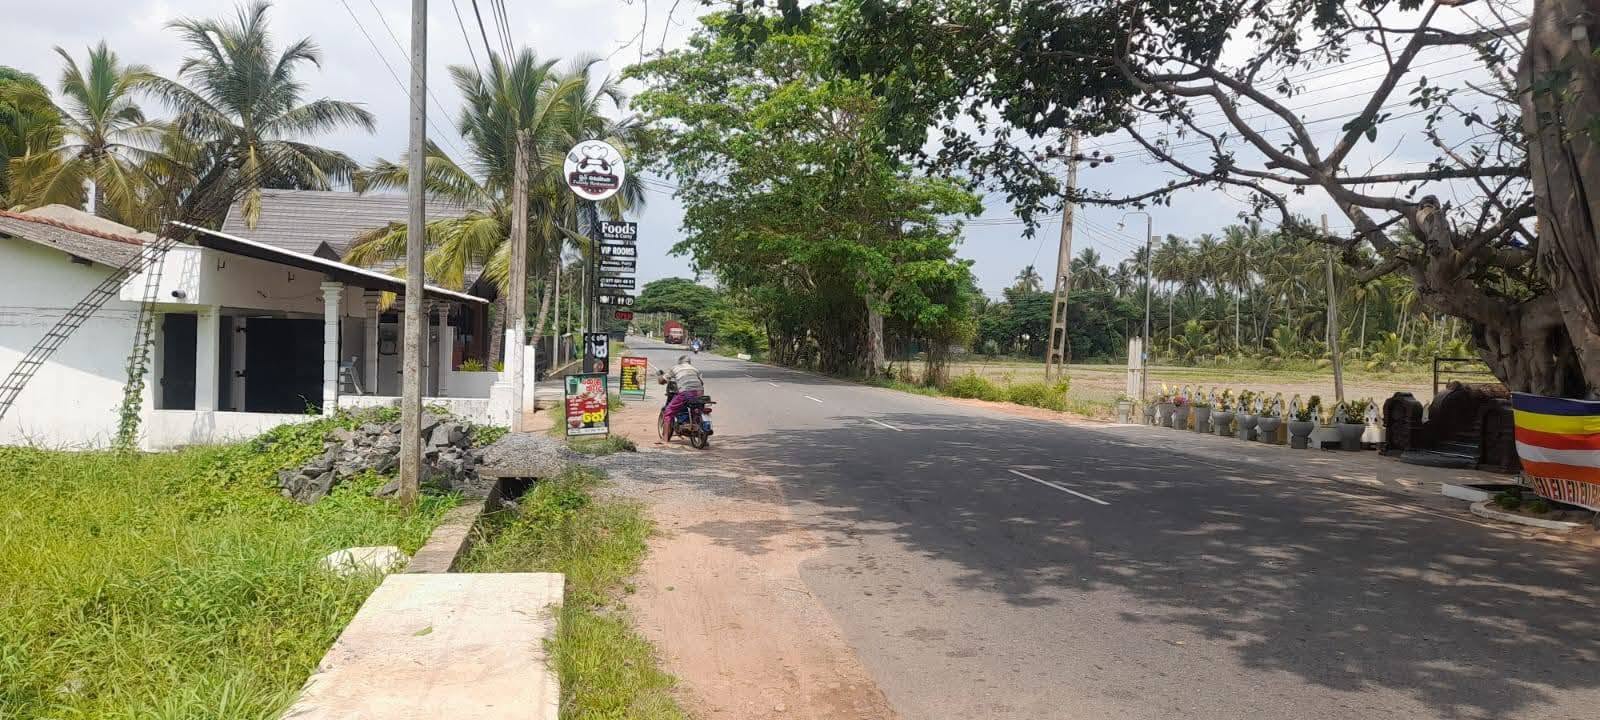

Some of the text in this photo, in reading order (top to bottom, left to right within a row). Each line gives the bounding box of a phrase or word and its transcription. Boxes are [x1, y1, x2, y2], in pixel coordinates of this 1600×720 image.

[601, 222, 635, 234] Foods
[601, 246, 635, 255] VIP ROOMS
